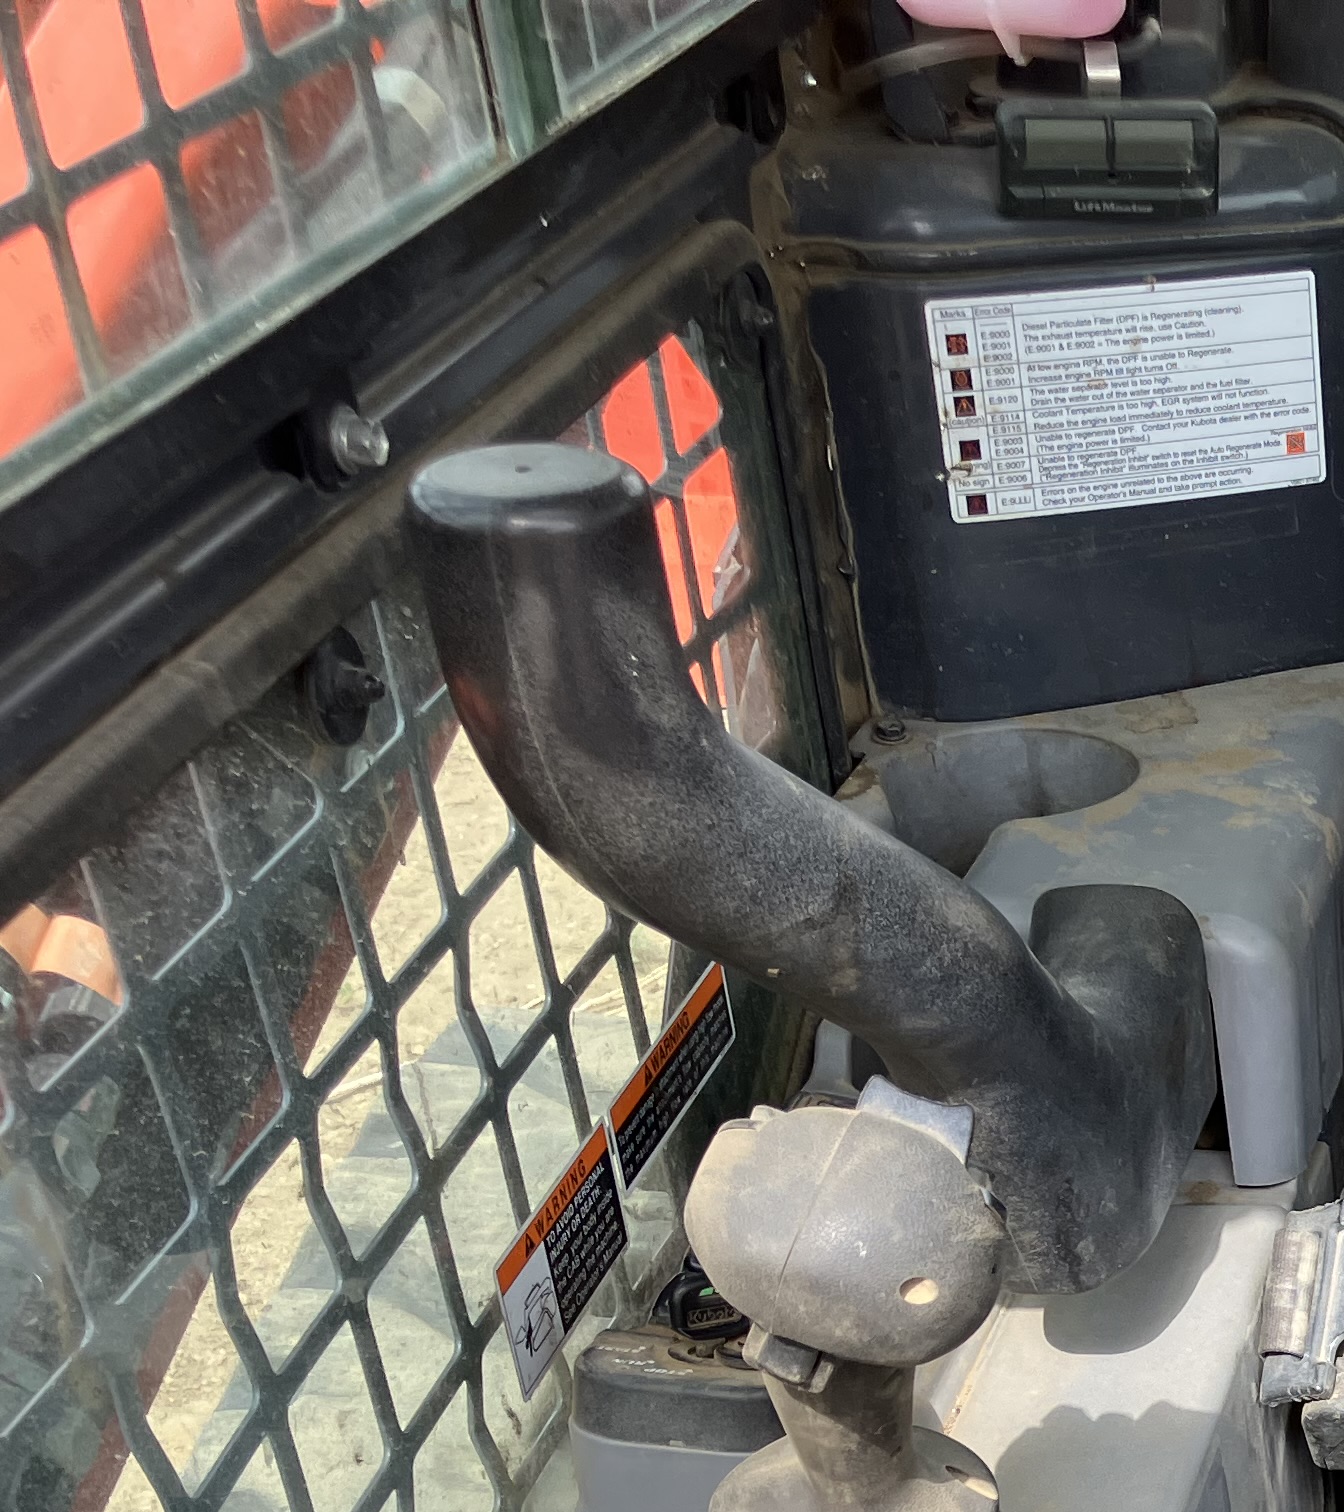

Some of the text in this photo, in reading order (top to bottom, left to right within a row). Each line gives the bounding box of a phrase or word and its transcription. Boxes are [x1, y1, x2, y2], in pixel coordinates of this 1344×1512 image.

[1074, 200, 1153, 213] LiftMaster
[651, 1012, 690, 1070] WARNING
[534, 1159, 586, 1236] WARNING
[549, 1182, 601, 1263] INJURY OR DEATH:
[555, 1203, 574, 1235] AVOID
[573, 1161, 604, 1207] PERSONAL
